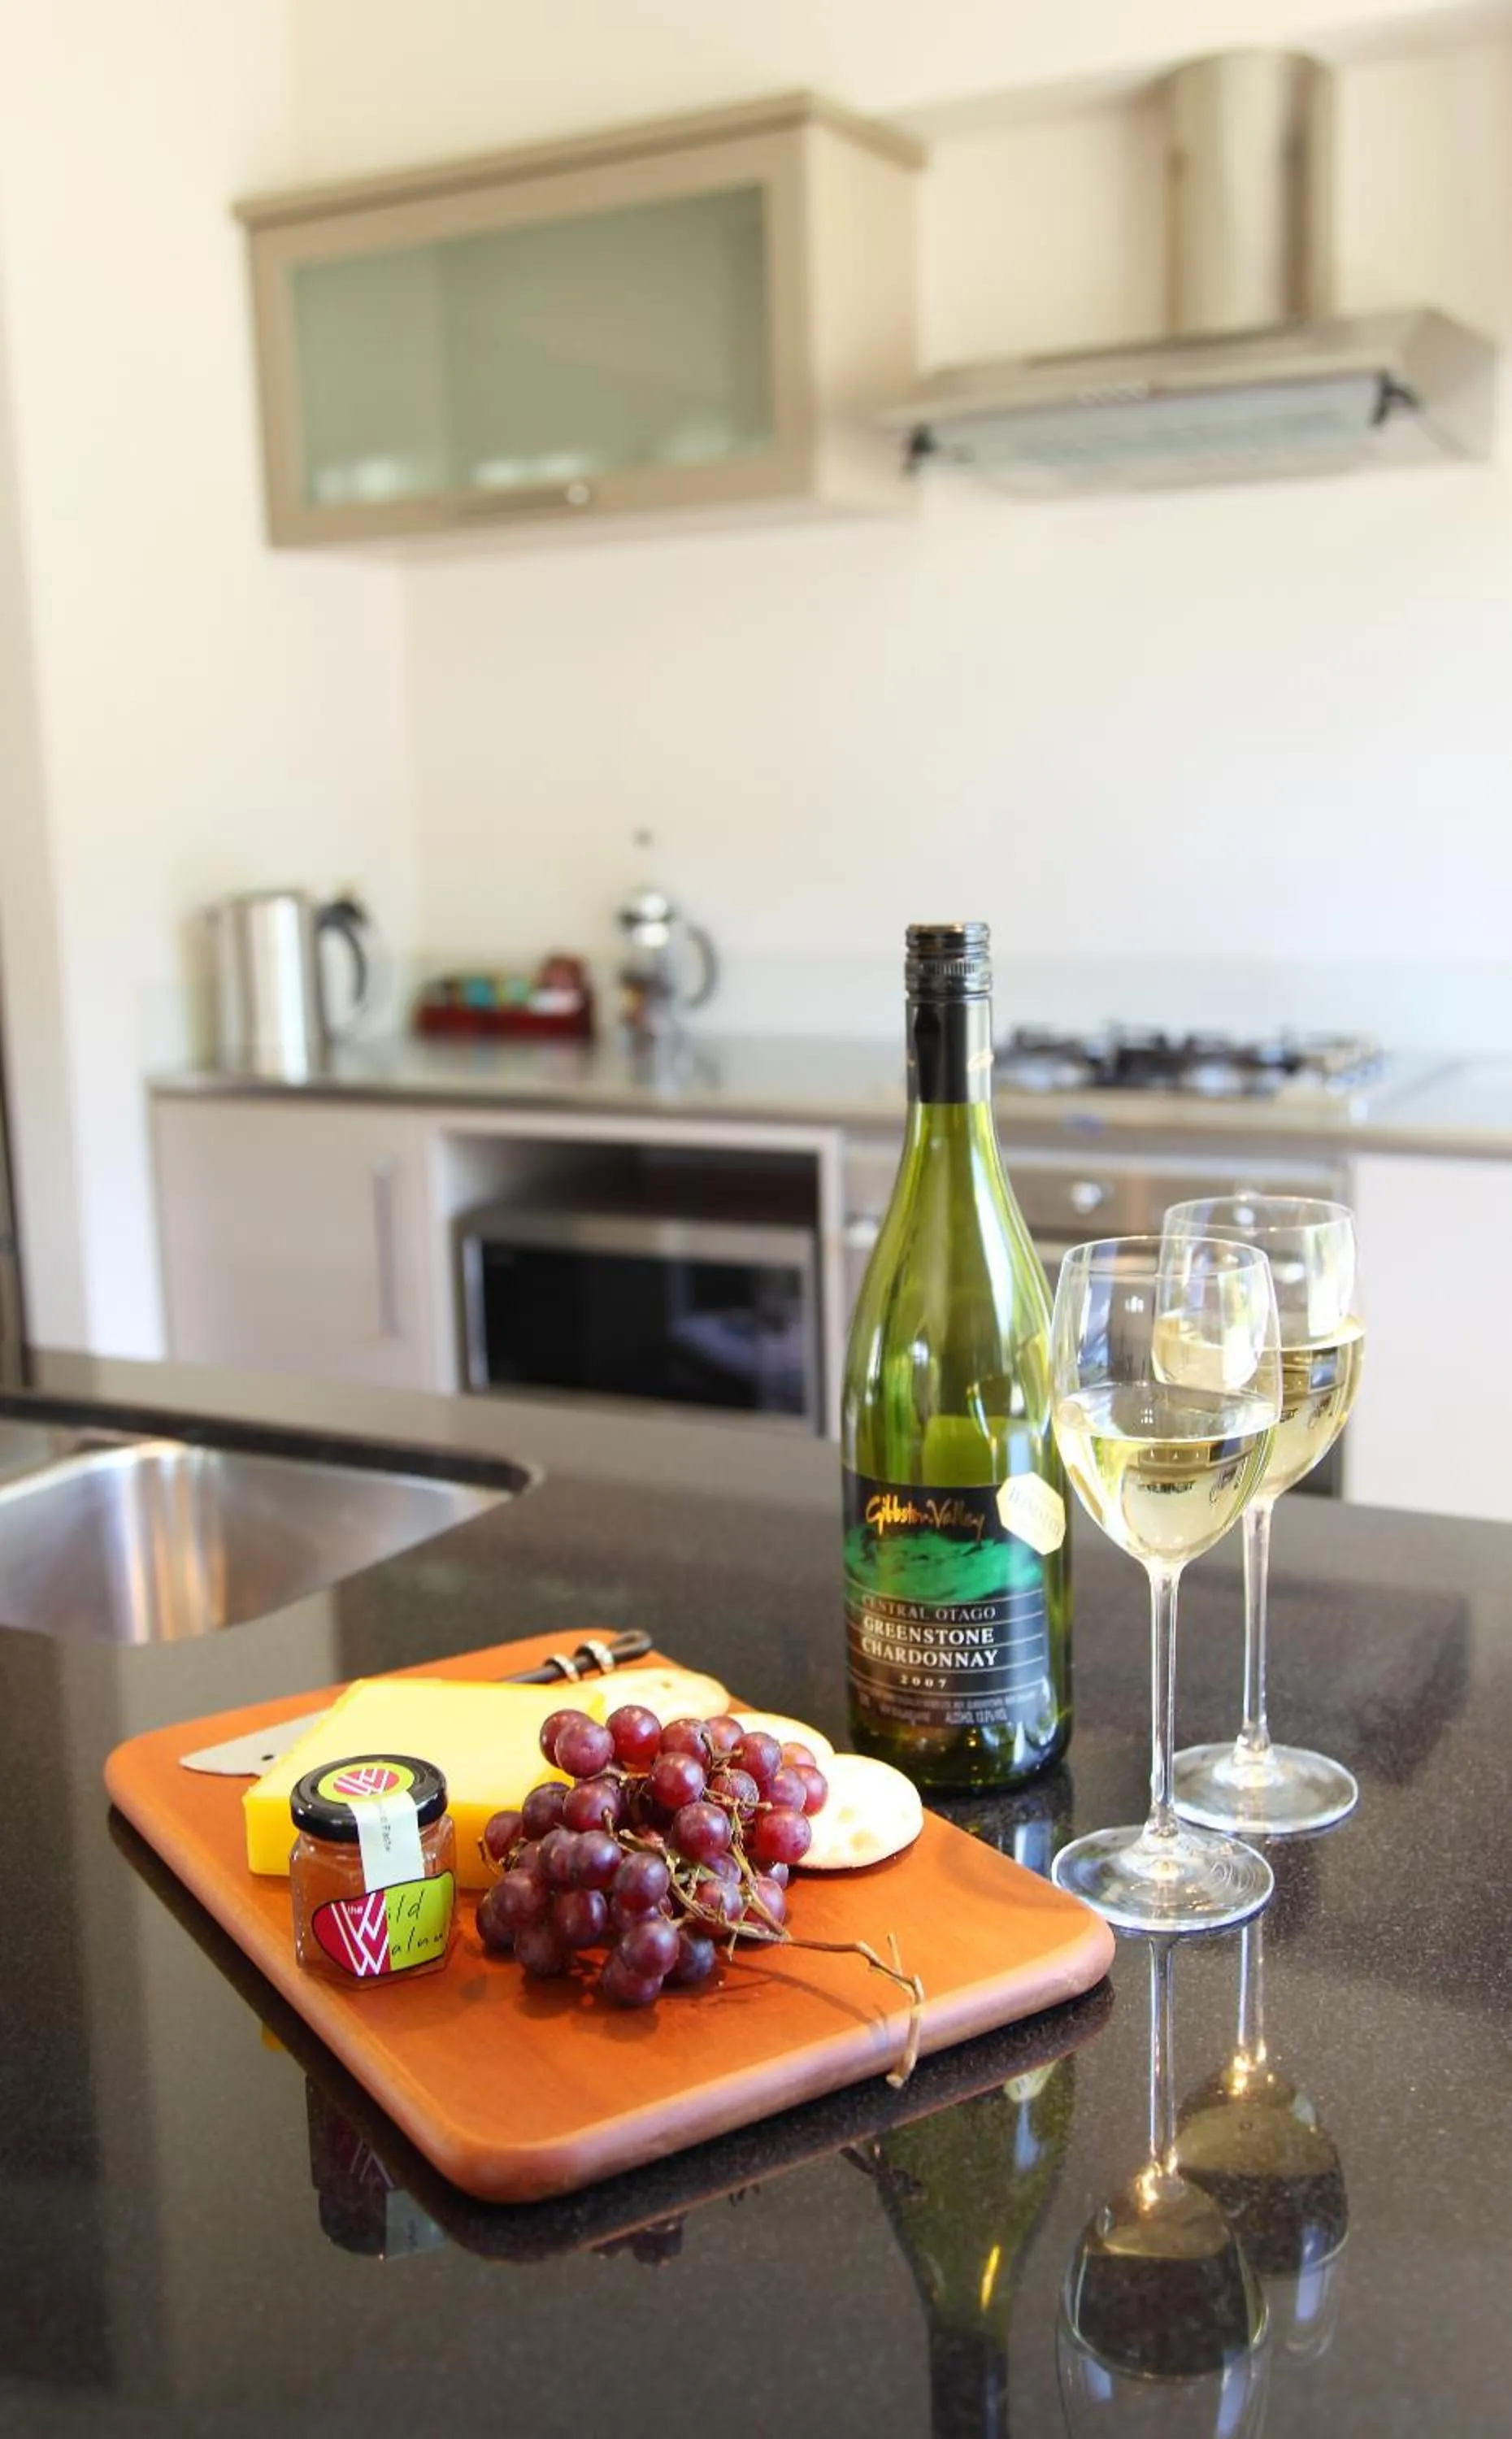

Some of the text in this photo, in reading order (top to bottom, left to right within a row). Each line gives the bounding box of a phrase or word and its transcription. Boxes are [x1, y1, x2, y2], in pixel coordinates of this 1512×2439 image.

[862, 1594, 997, 1622] CENTRAL OTAGO
[862, 1615, 995, 1646] GREENSTONE
[861, 1636, 998, 1668] CHARDONNAY
[899, 1674, 948, 1689] 2007
